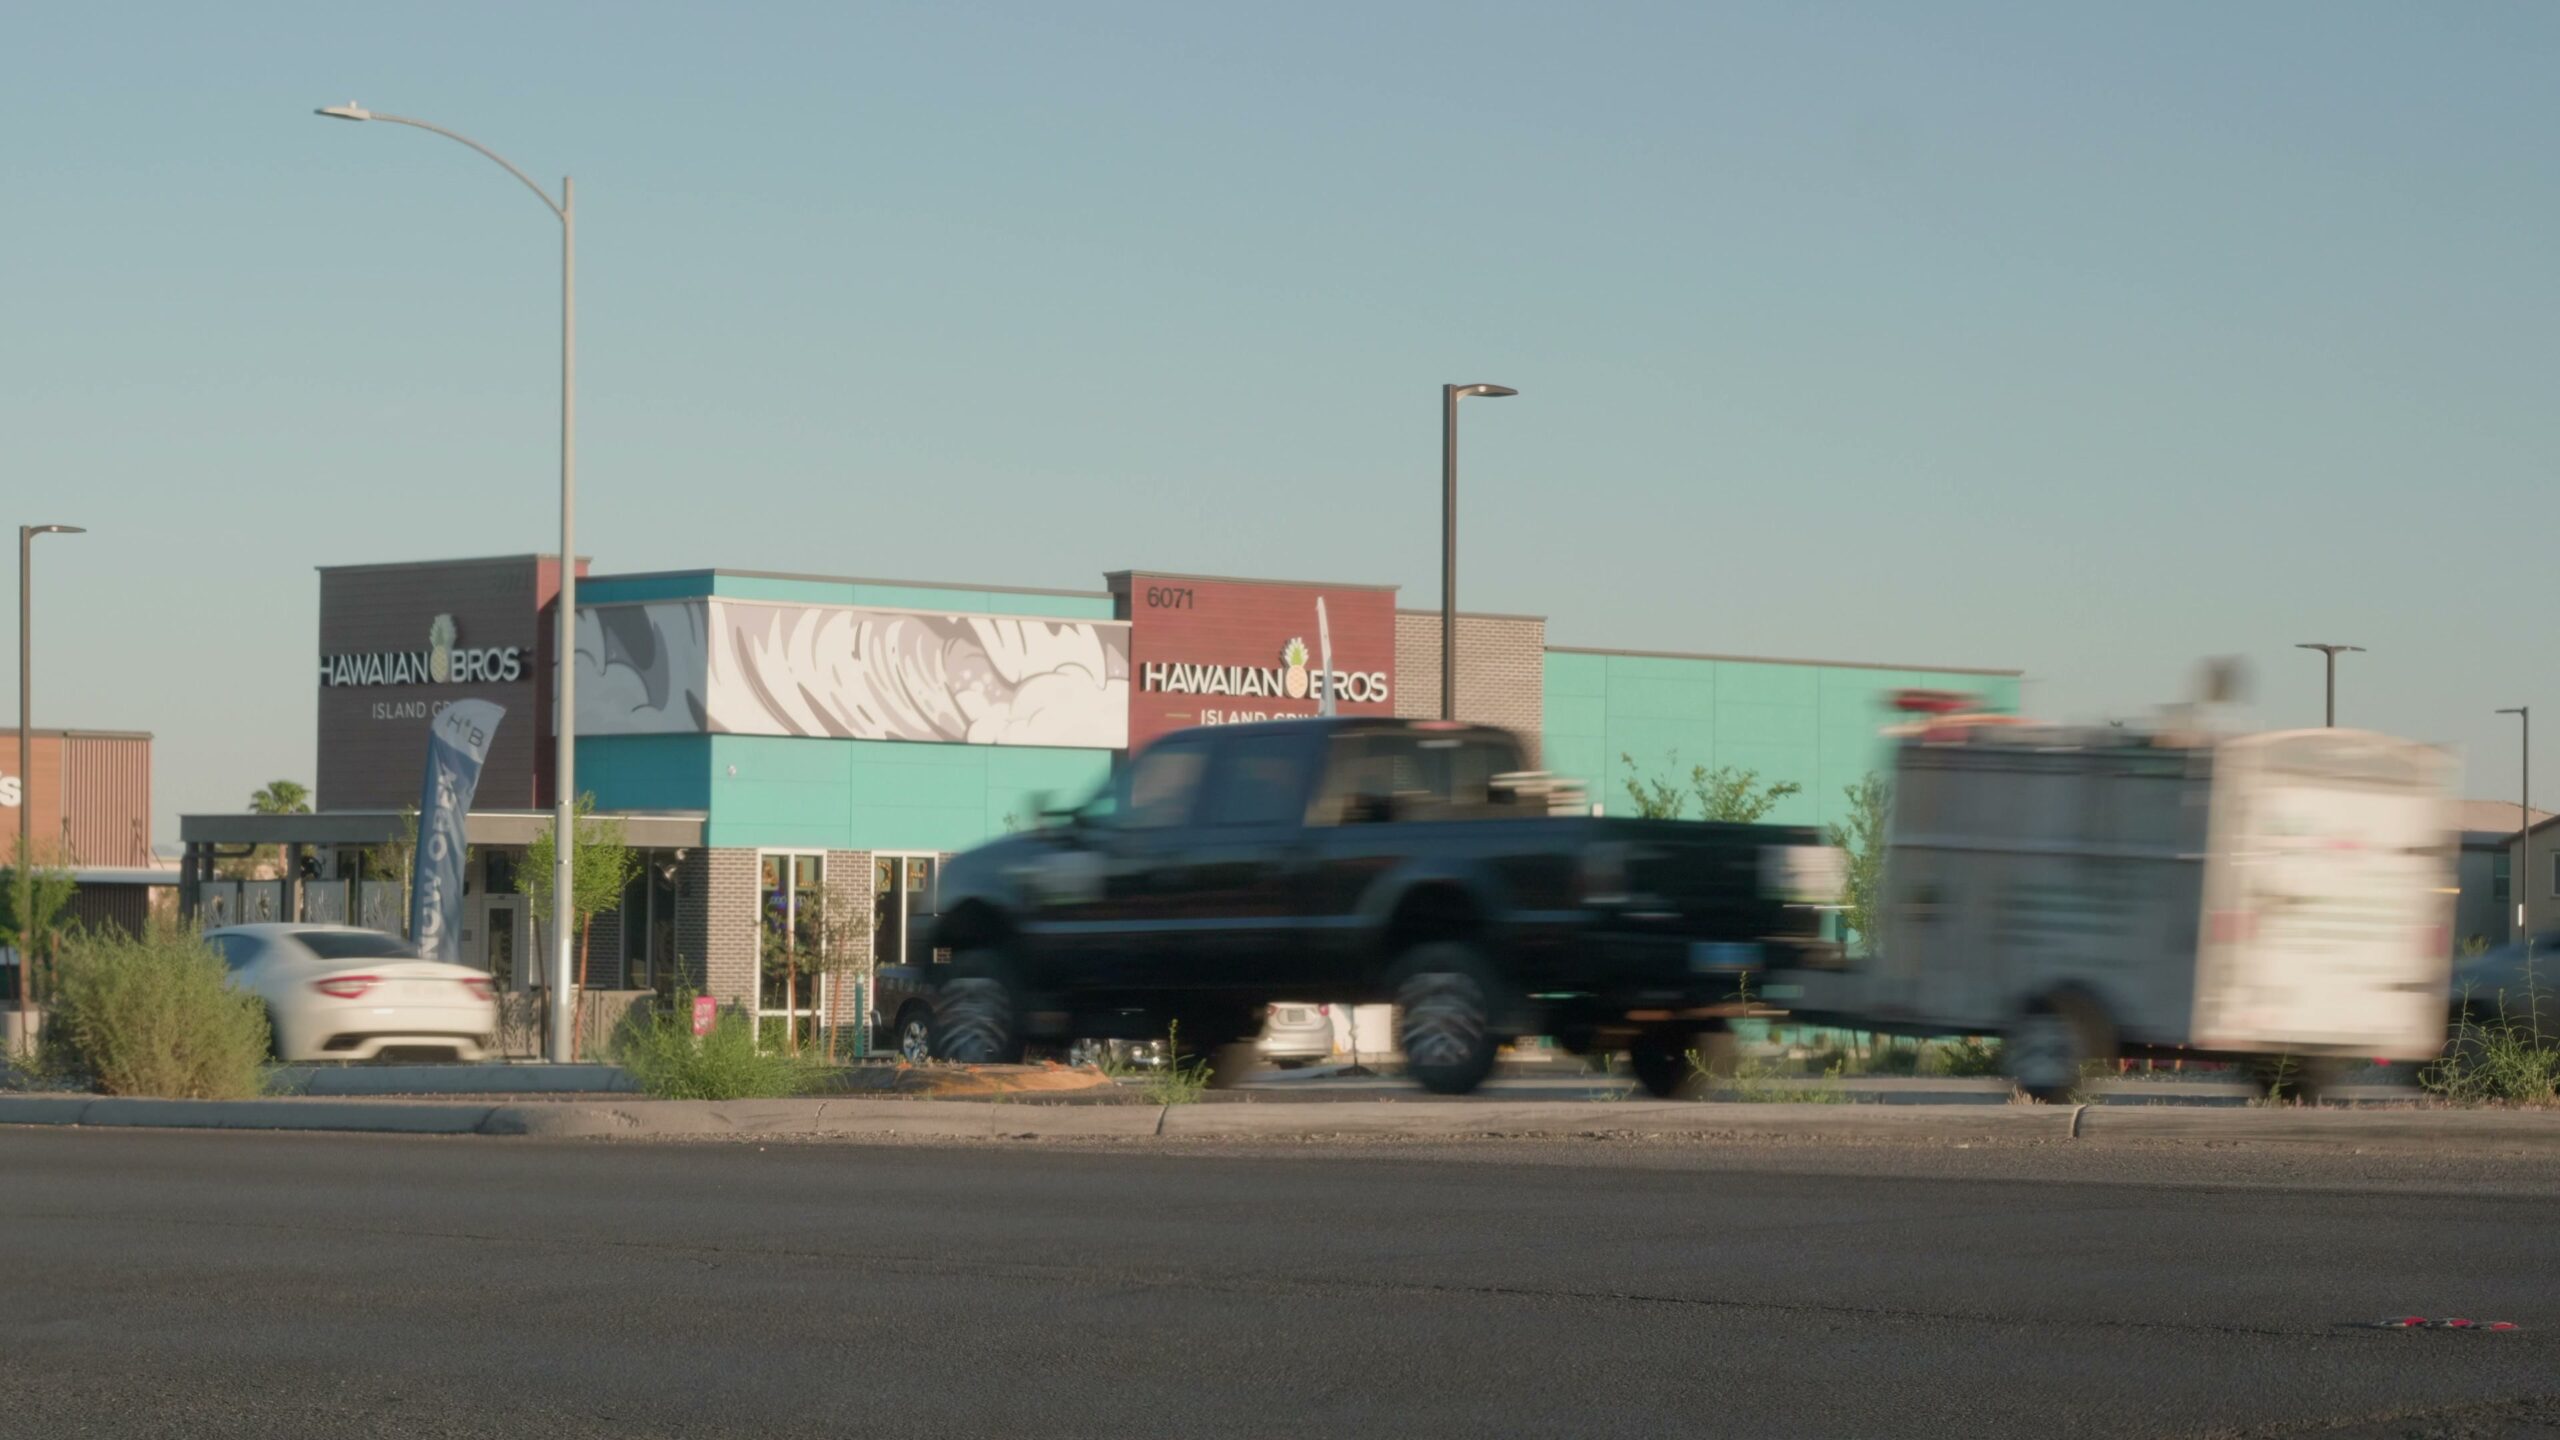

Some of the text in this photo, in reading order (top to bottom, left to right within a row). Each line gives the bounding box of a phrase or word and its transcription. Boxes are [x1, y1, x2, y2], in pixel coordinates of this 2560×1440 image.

[1147, 586, 1193, 609] 6071
[319, 646, 521, 687] HAWAIIAN BROS
[1142, 660, 1283, 697] HAWAIIAN
[372, 701, 427, 720] ISLAND
